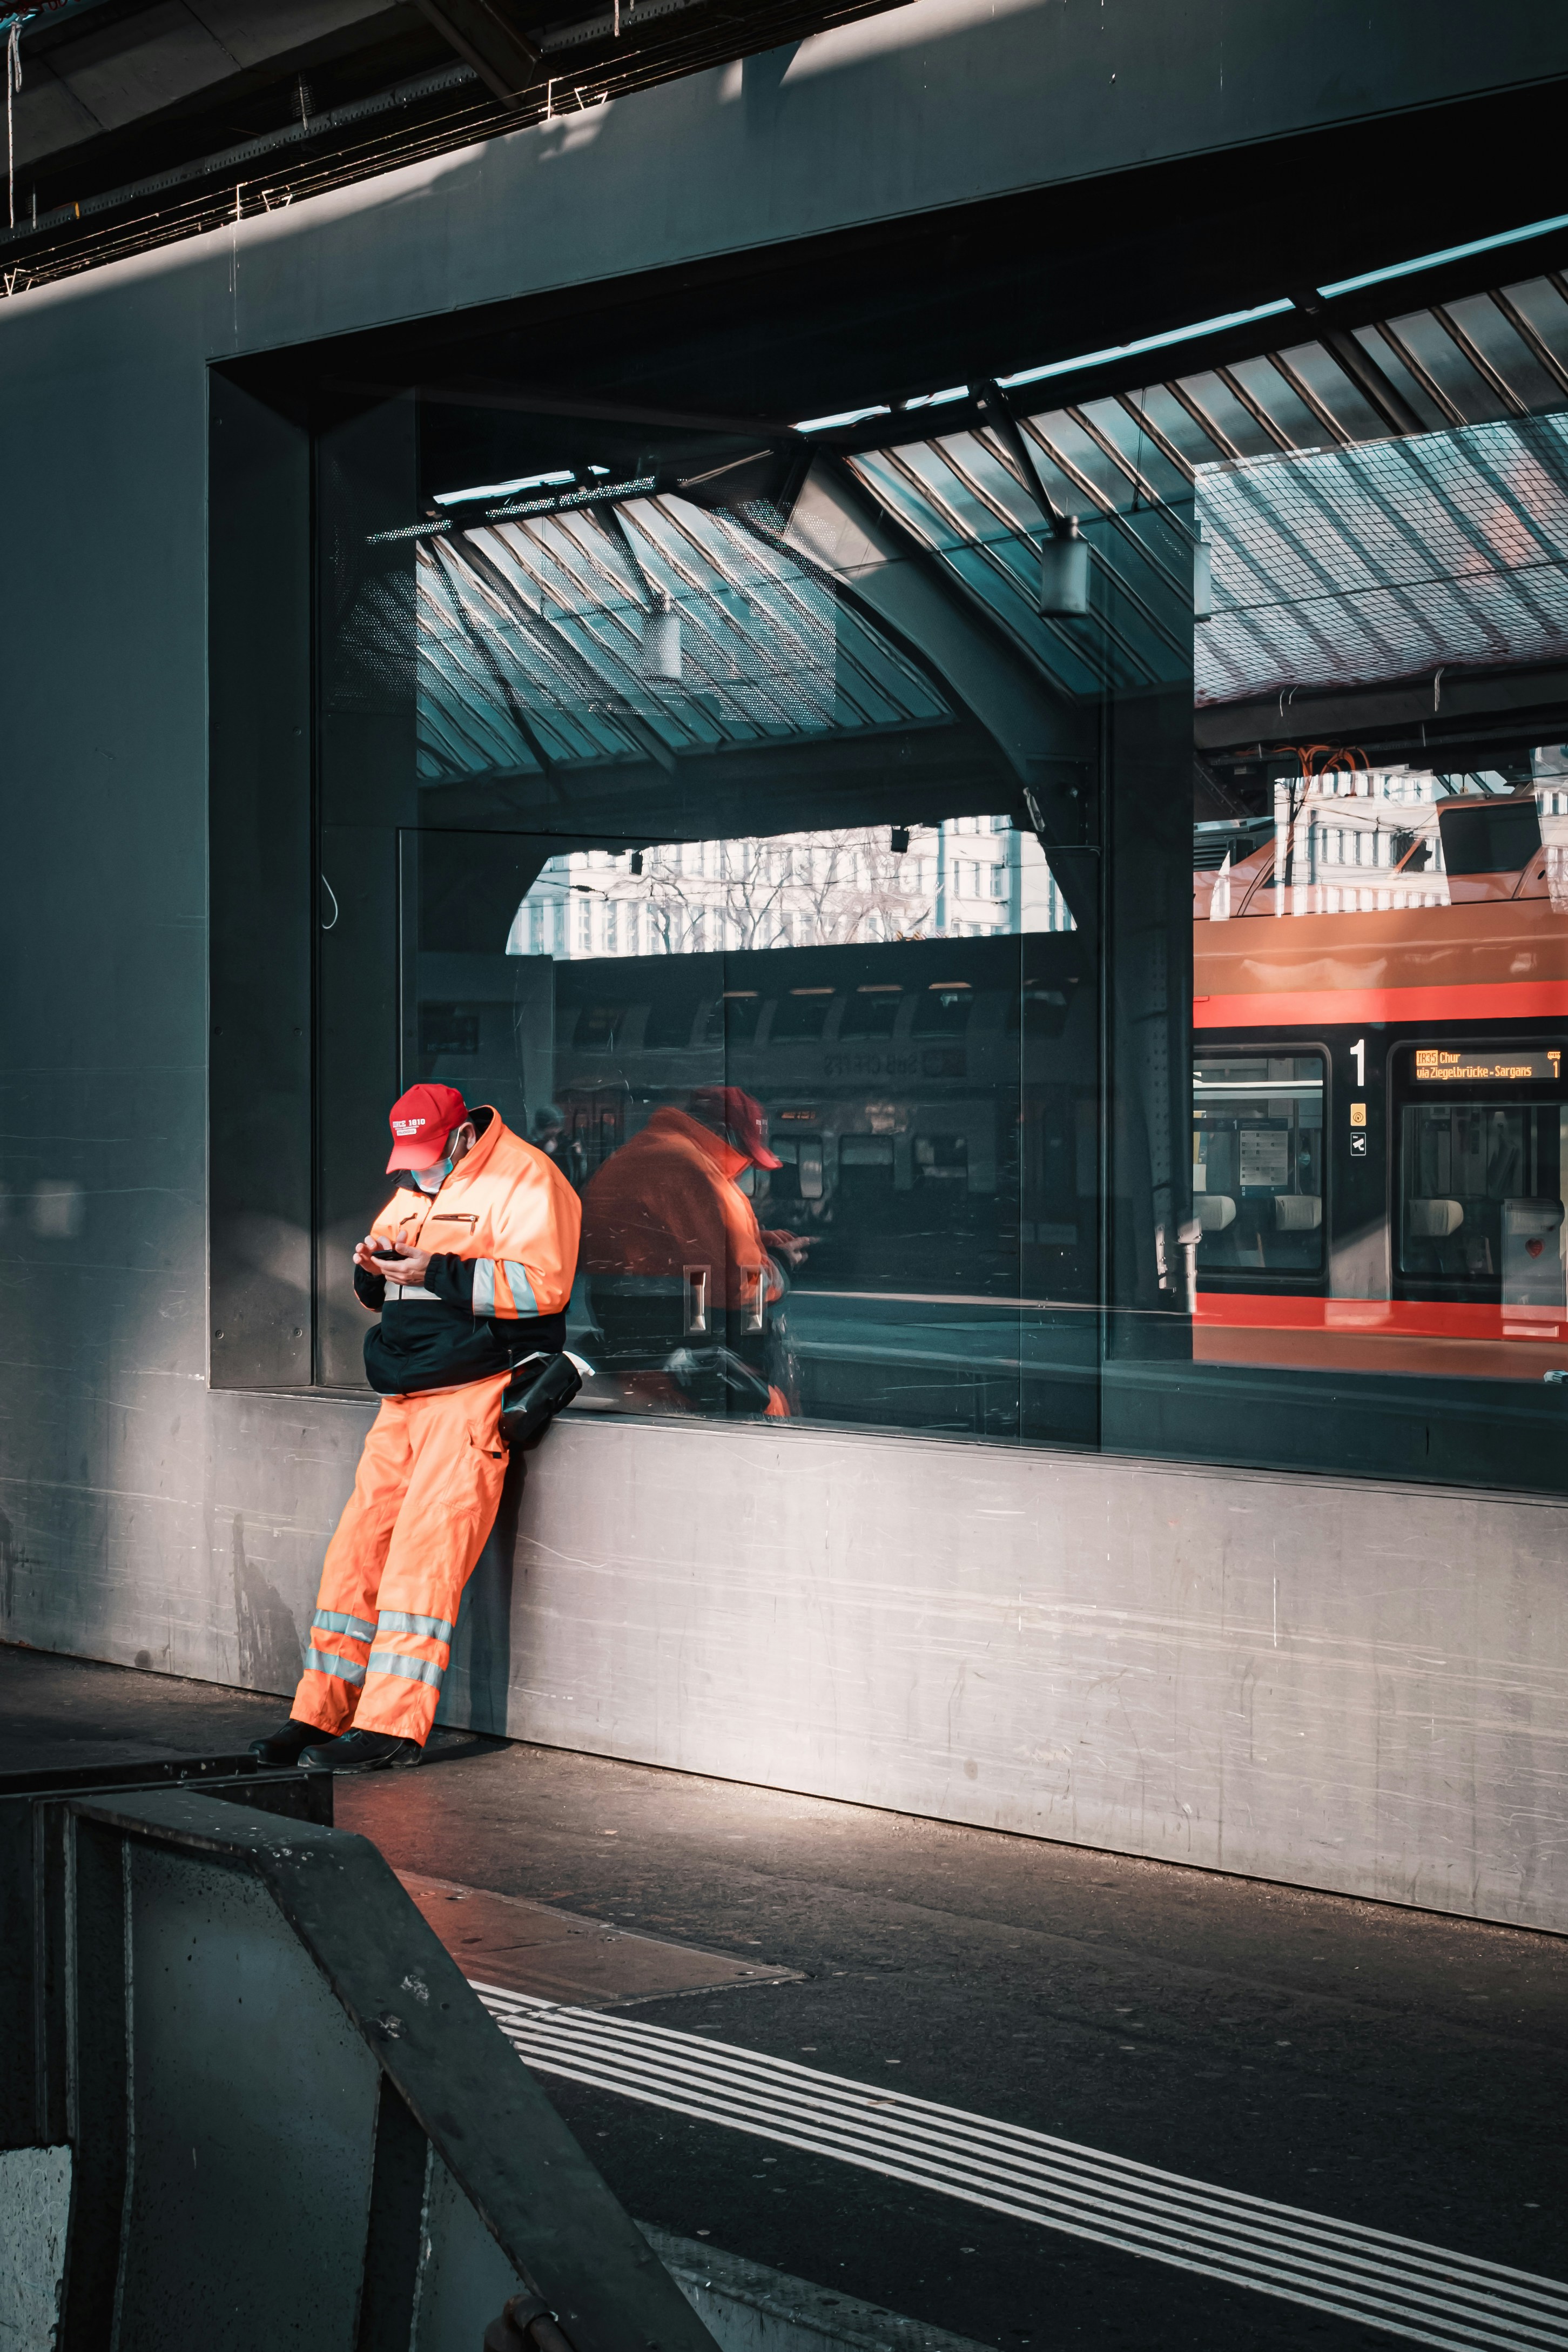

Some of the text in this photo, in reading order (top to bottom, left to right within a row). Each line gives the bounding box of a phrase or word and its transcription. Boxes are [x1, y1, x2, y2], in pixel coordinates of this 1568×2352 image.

[1350, 1039, 1364, 1086] 1
[1439, 1052, 1461, 1064] Chur
[1416, 1067, 1429, 1078] via
[1430, 1066, 1489, 1080] Ziegelbrücke
[1495, 1065, 1532, 1079] Sargans
[1553, 1060, 1558, 1078] 1
